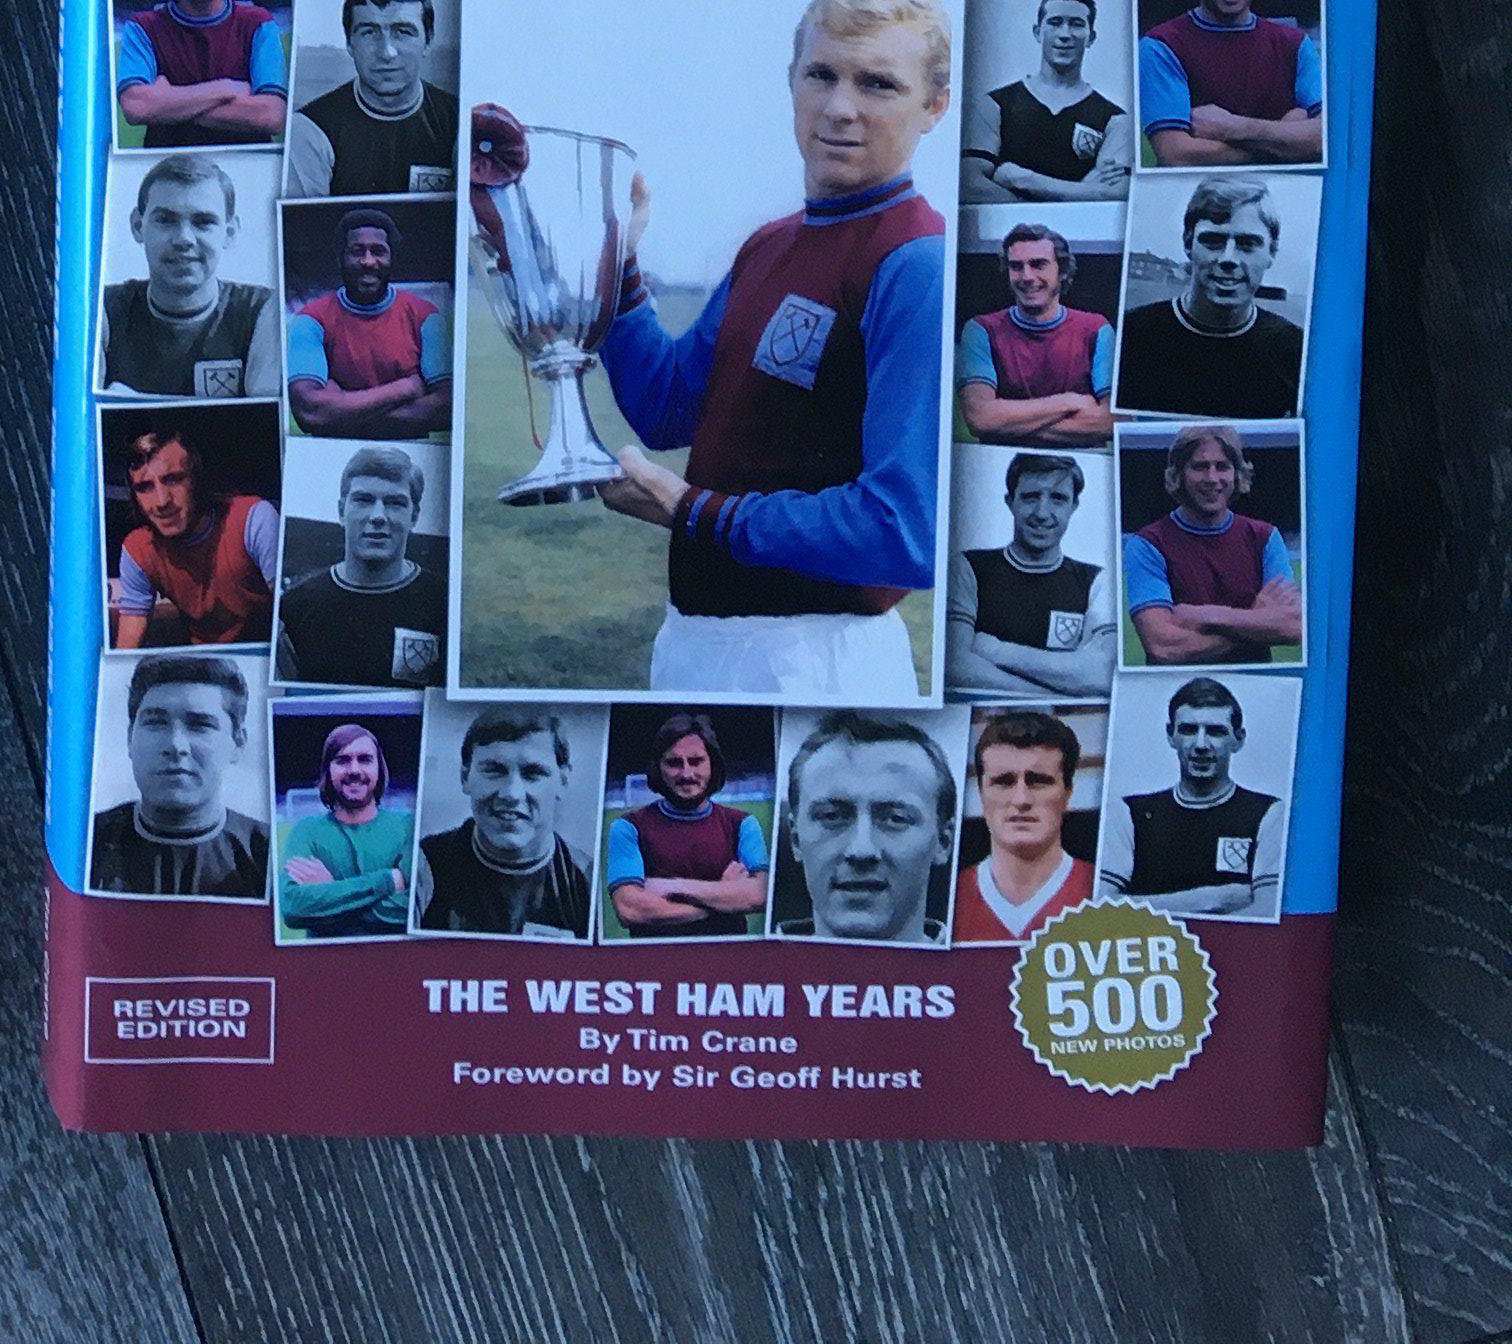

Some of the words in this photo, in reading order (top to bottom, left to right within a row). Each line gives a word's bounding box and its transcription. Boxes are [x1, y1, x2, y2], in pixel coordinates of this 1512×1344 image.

[1043, 935, 1180, 979] OVER
[113, 998, 251, 1019] REVISED
[422, 978, 509, 1013] THE
[524, 979, 662, 1015] WEST
[676, 982, 785, 1018] HAM
[801, 984, 956, 1018] YEARS
[1046, 973, 1183, 1038] 500
[117, 1018, 246, 1039] EDITION
[579, 1026, 621, 1055] By
[626, 1028, 689, 1052] Tim
[701, 1029, 798, 1054] Crane
[1050, 1038, 1098, 1056] NEW
[1103, 1033, 1186, 1052] PHOTOS
[453, 1061, 610, 1085] Foreword
[622, 1063, 662, 1092] by
[672, 1064, 720, 1088] Sir
[730, 1065, 822, 1089] Geoff
[831, 1066, 922, 1089] Hurst
